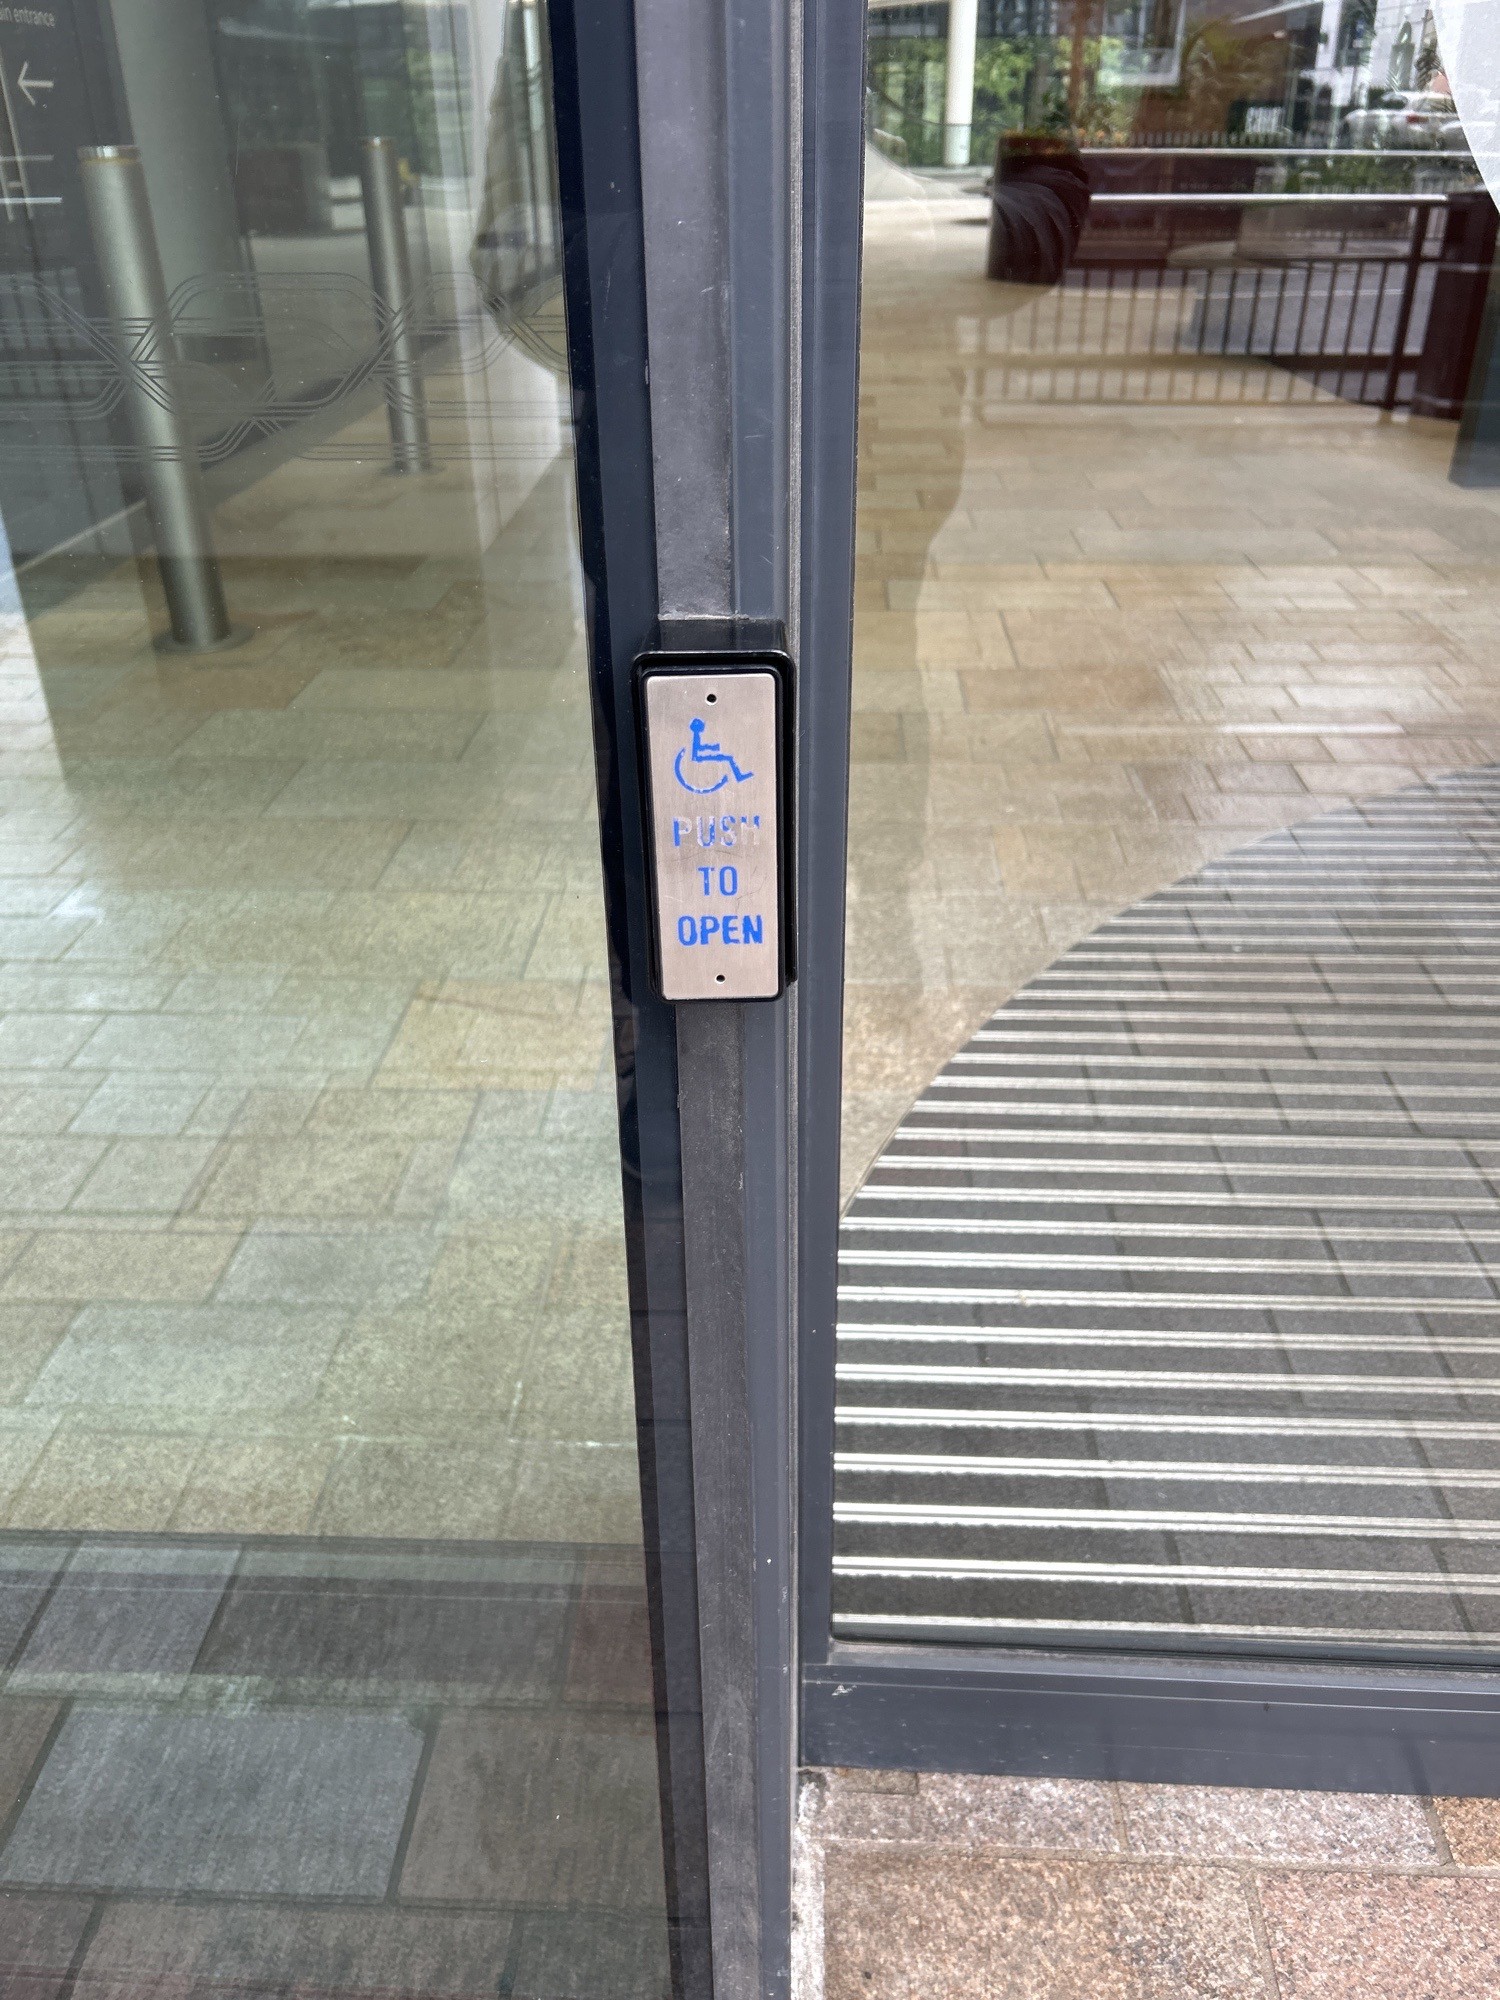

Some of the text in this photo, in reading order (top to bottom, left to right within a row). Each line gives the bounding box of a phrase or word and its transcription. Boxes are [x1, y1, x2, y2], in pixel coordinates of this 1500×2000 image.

[673, 815, 760, 847] PUSH
[698, 866, 738, 896] TO
[677, 914, 763, 946] OPEN
